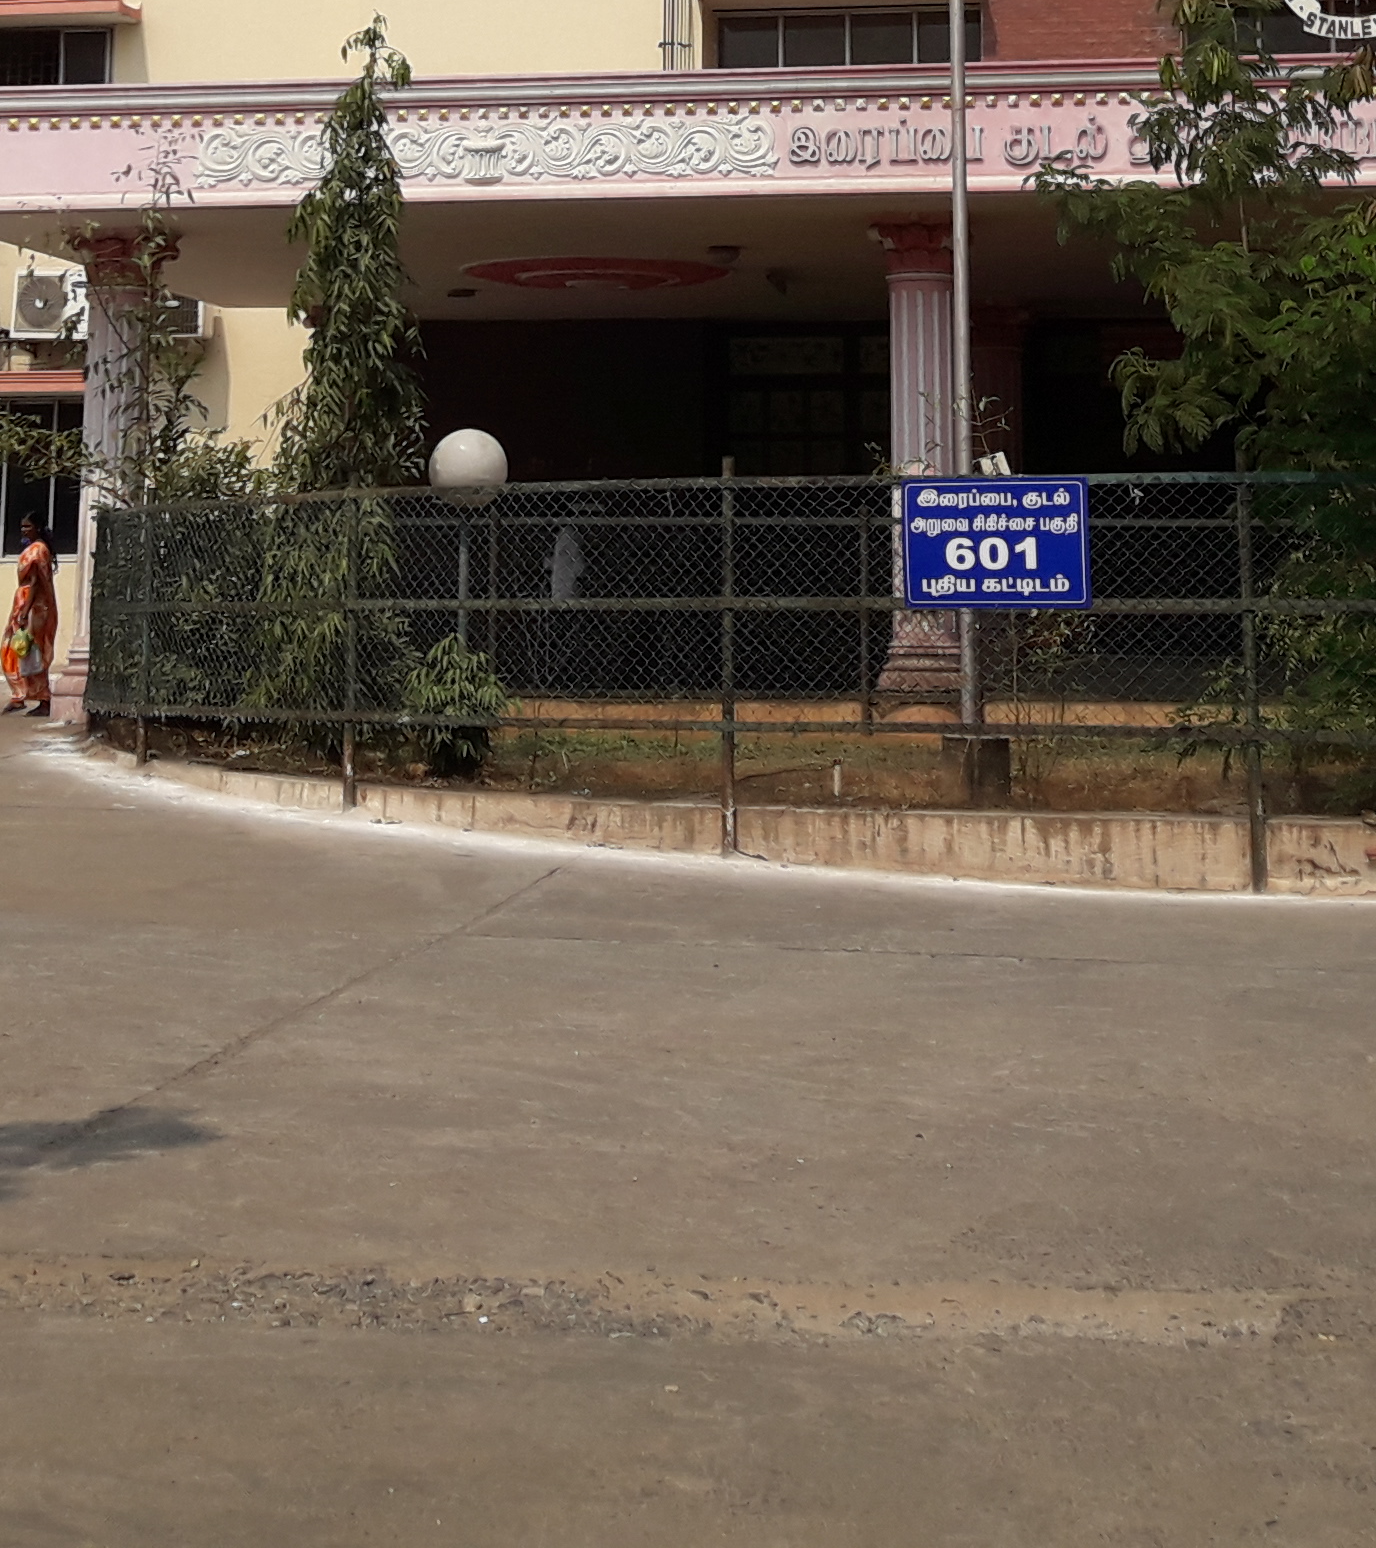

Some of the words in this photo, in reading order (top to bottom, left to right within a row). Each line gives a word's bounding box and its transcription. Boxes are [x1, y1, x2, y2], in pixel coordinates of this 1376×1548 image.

[916, 487, 1018, 510] இரைப்பை,
[1022, 486, 1071, 510] குடல்
[910, 516, 970, 537] அறுவை
[972, 512, 1037, 533] சிகிச்சை
[1039, 512, 1079, 536] பகுதி
[944, 535, 1038, 571] 601
[921, 574, 976, 597] புதிய
[981, 573, 1071, 597] கட்டிடம்
